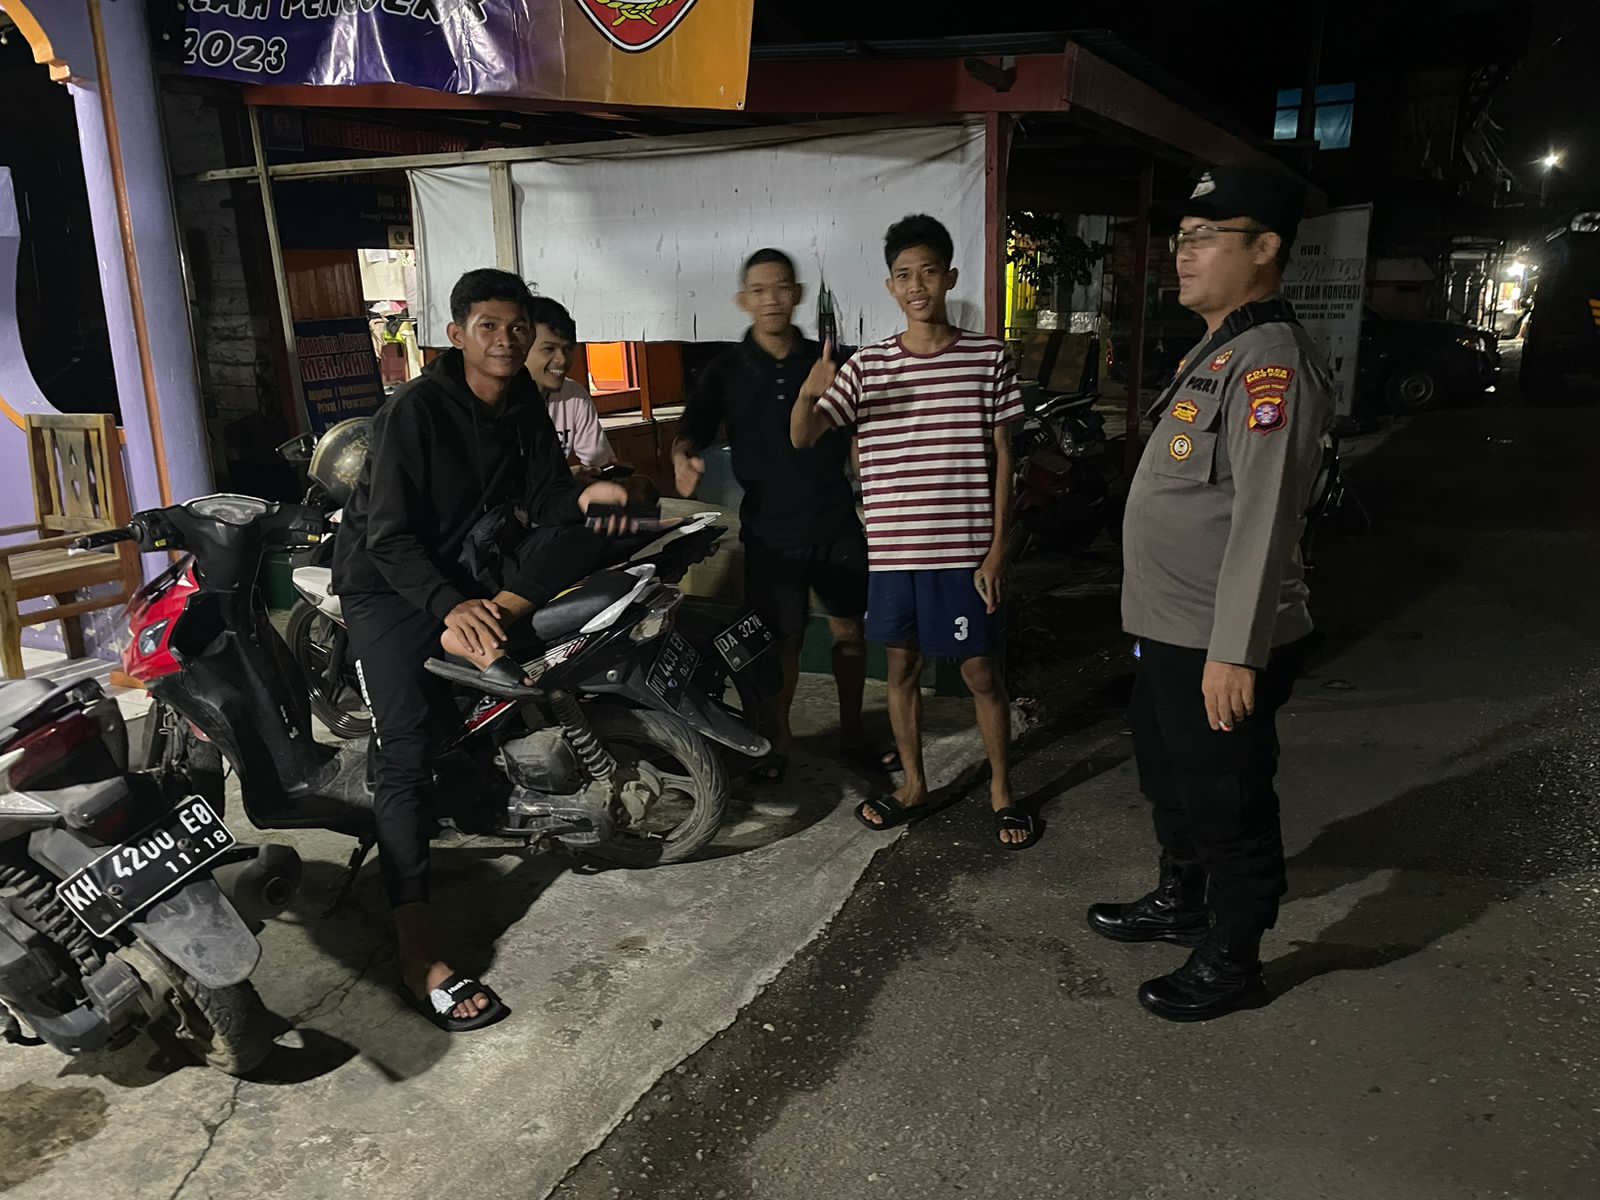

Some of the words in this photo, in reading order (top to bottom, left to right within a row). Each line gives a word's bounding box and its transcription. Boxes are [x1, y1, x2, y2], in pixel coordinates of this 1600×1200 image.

[184, 28, 288, 74] 2023
[719, 632, 739, 653] DA
[953, 615, 969, 641] 3
[64, 873, 103, 912] KH
[111, 828, 176, 879] 4200
